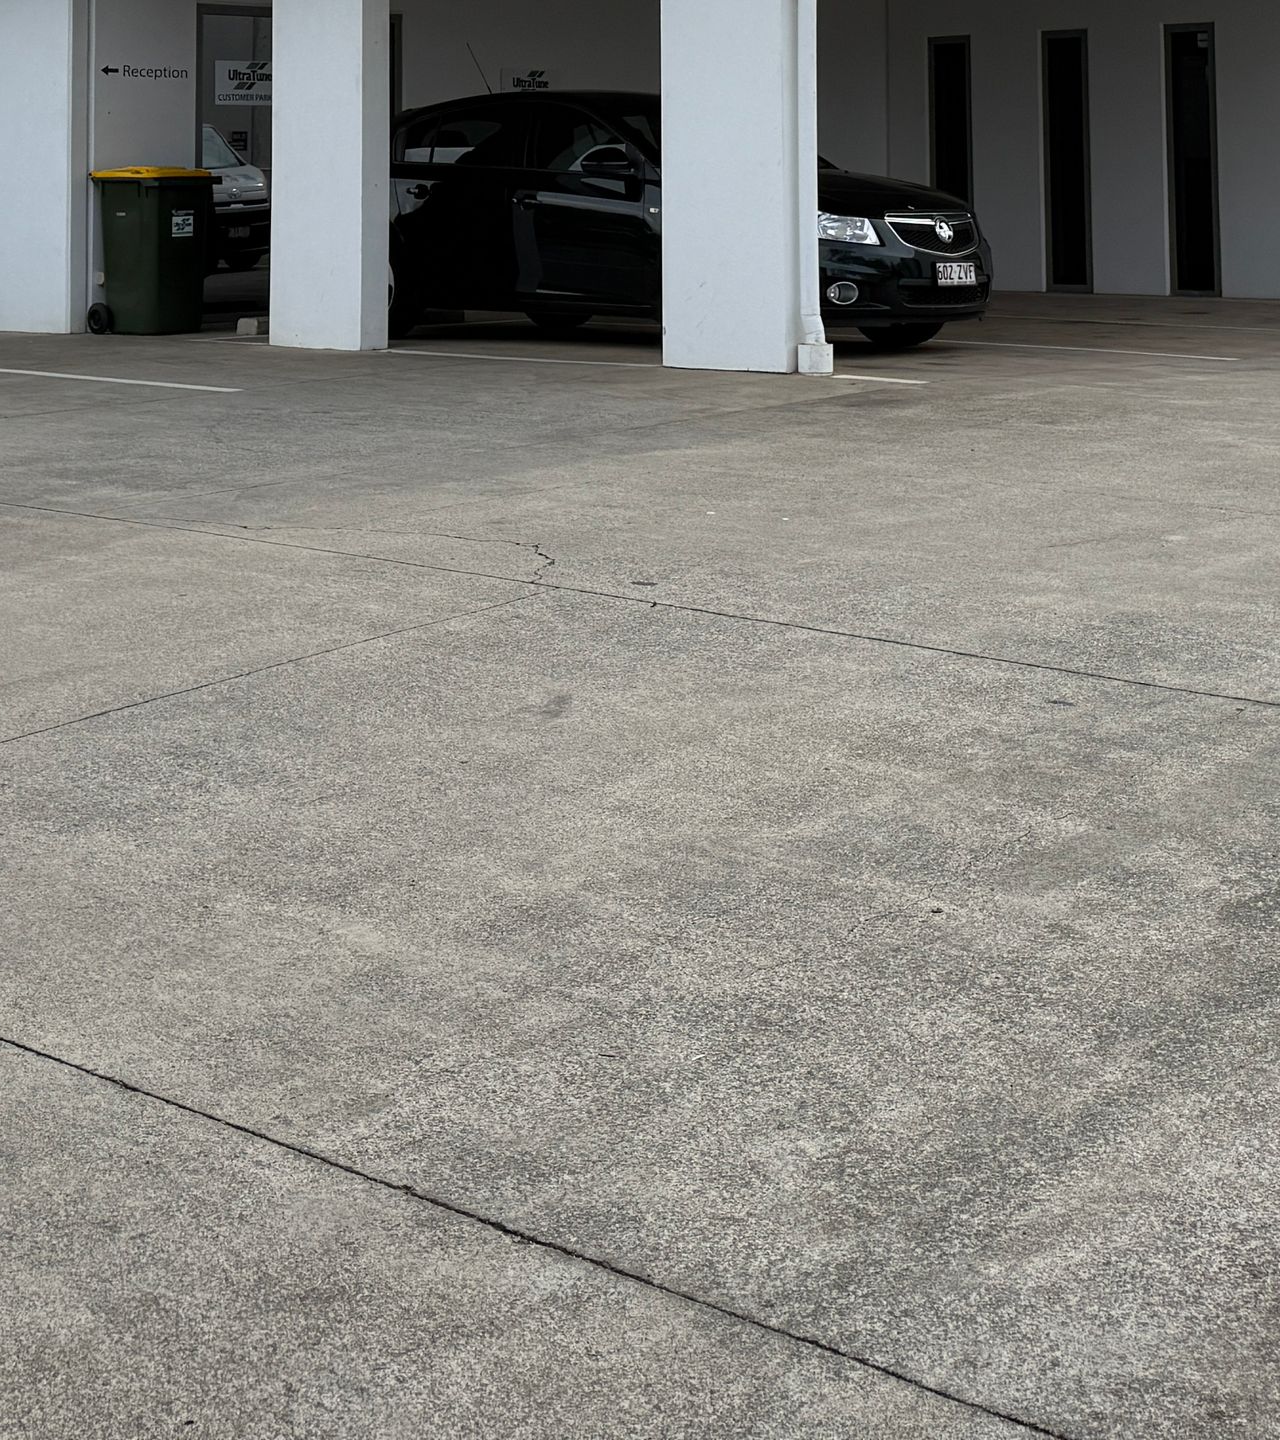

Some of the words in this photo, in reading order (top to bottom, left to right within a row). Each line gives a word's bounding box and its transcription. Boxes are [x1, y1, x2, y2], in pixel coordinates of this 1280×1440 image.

[122, 64, 188, 80] Reception
[218, 94, 254, 102] CUSTOMER
[938, 265, 954, 280] 602
[957, 264, 974, 280] ZVF
